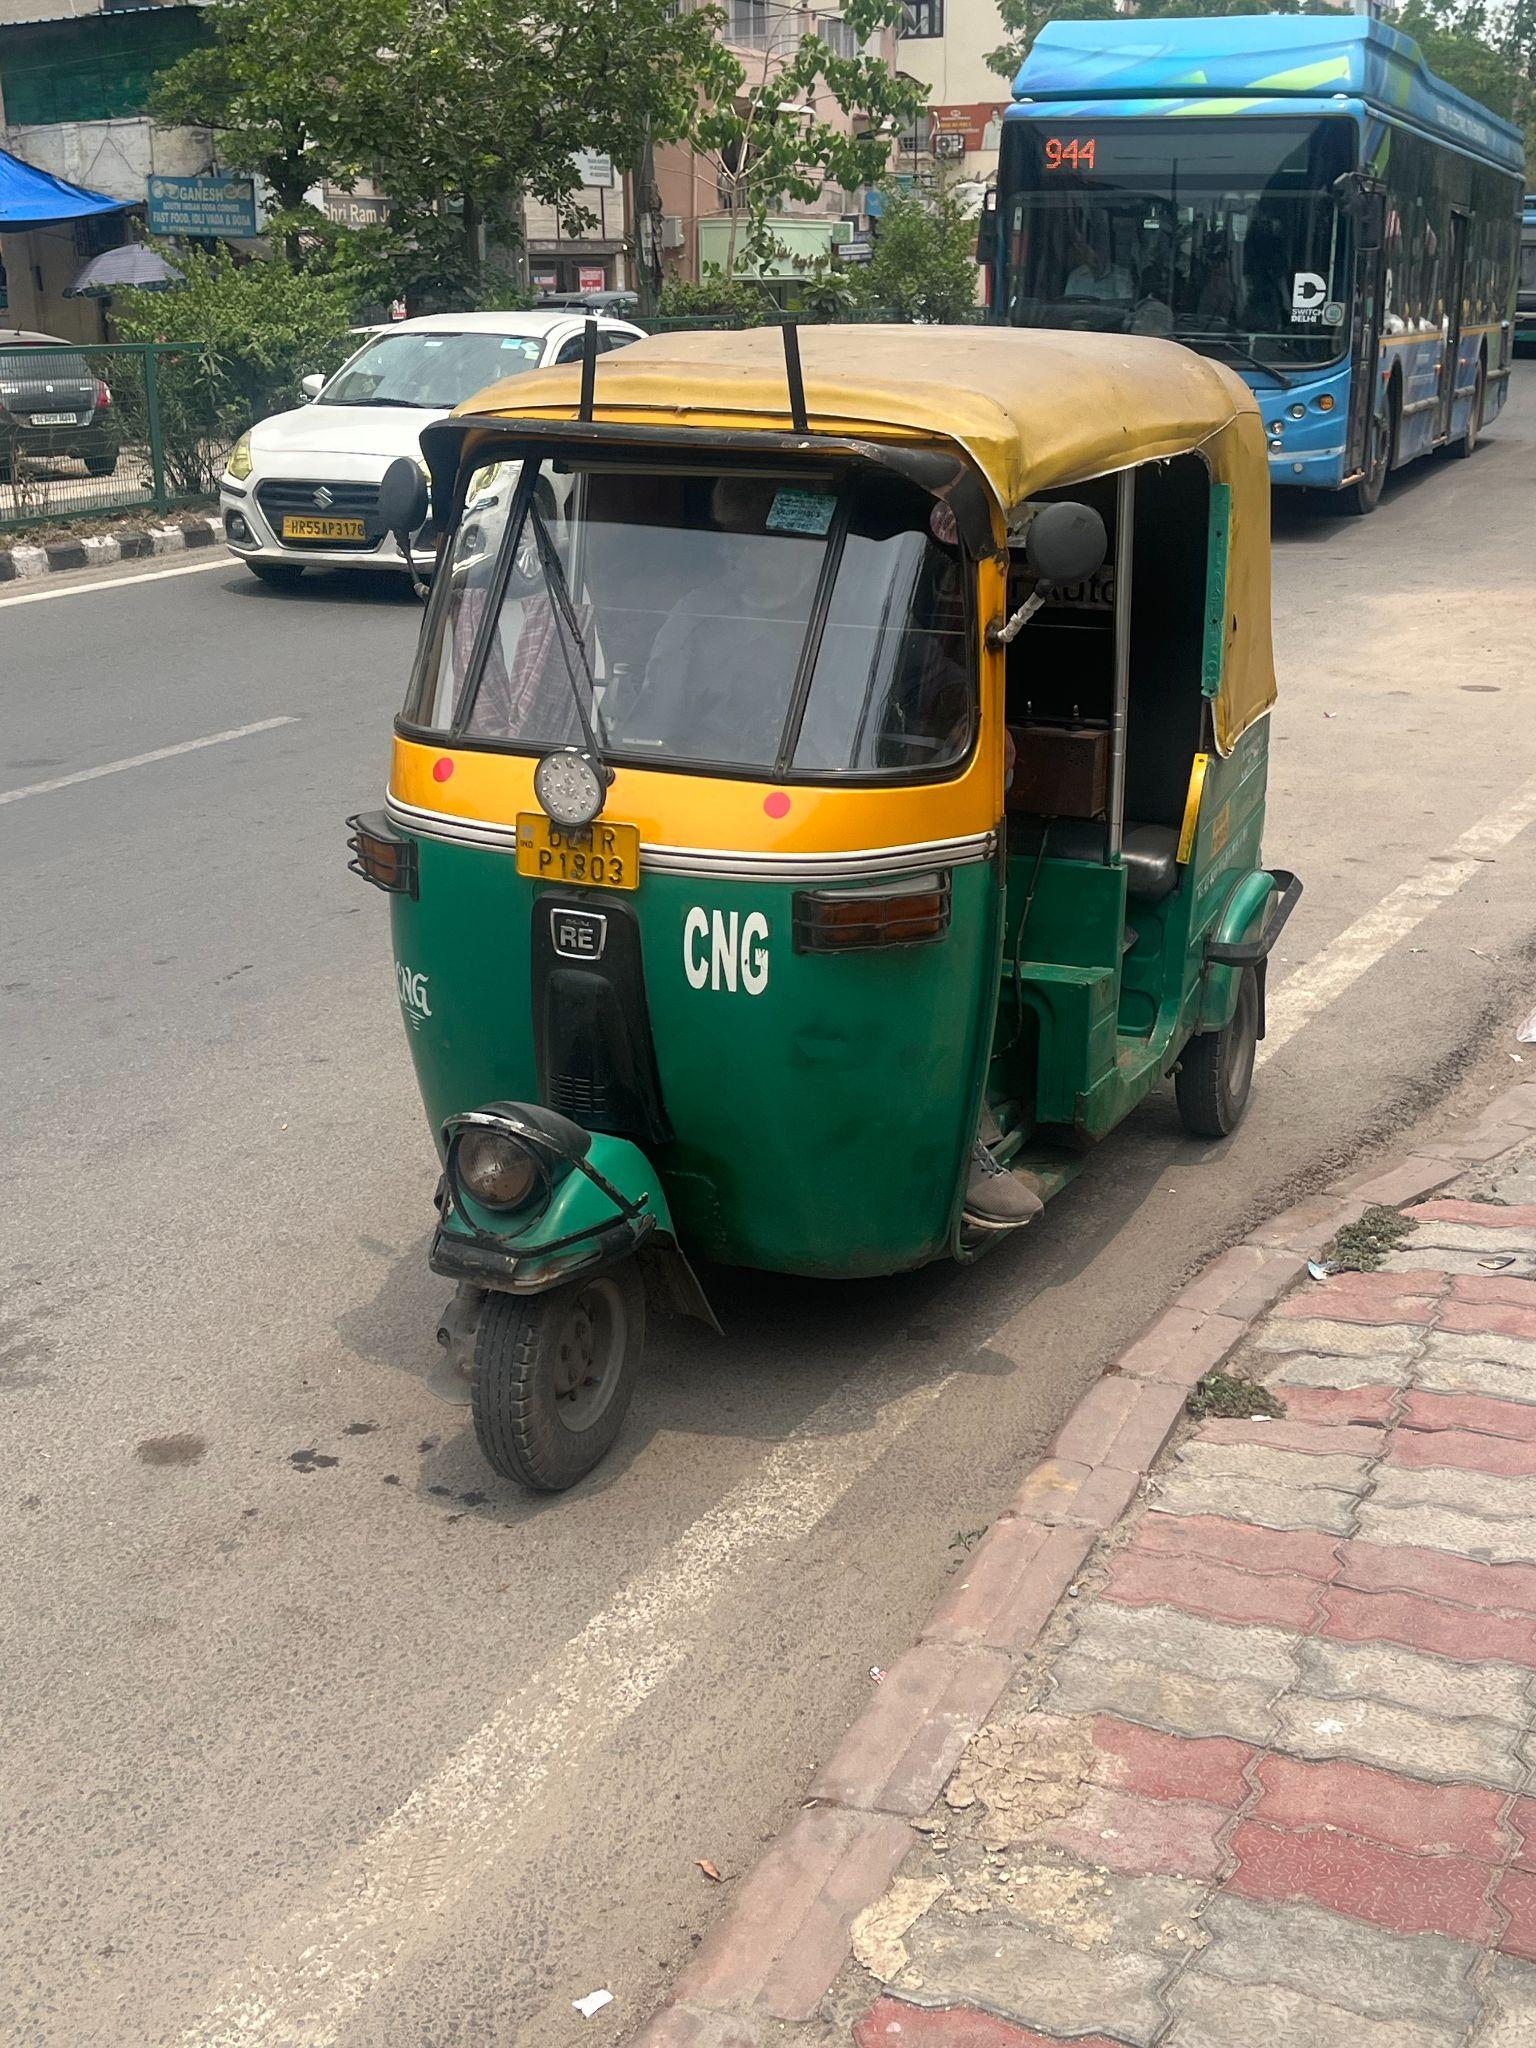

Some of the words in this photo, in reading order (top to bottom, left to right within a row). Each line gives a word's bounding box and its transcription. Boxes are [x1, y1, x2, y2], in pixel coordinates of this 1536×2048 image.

[1045, 138, 1095, 169] 944
[180, 187, 224, 201] GANESH
[153, 212, 169, 223] FAST
[232, 215, 251, 226] DOSA
[322, 203, 347, 223] Shri
[350, 203, 377, 223] Ram
[1291, 315, 1317, 323] DELHI
[1292, 308, 1324, 316] SWITCH
[539, 847, 623, 884] P1803
[560, 925, 593, 949] RE
[683, 906, 768, 995] CNG
